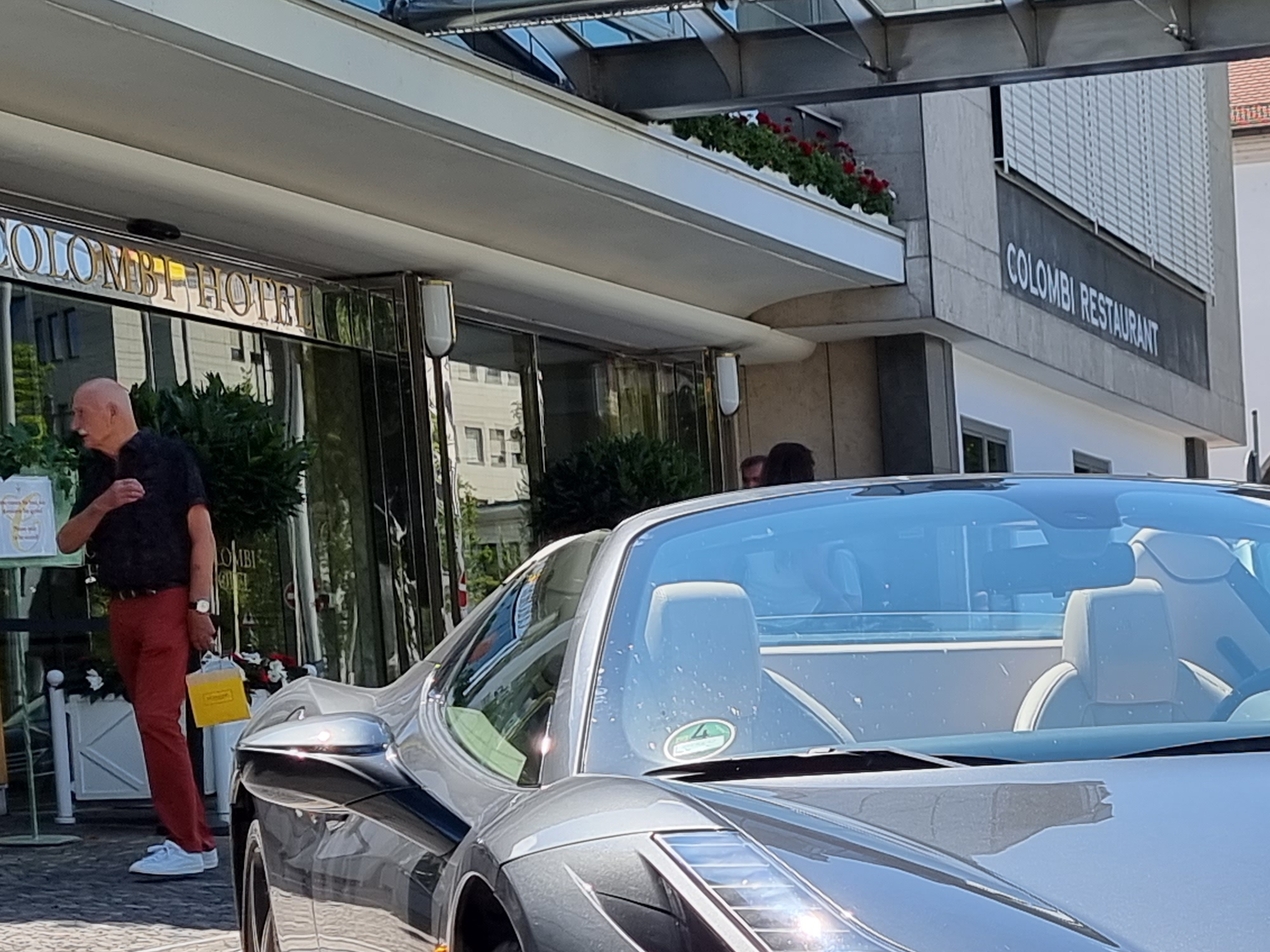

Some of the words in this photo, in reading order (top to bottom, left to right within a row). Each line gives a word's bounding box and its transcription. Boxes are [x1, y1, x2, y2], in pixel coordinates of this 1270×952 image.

[196, 262, 313, 331] HOTEL
[1007, 242, 1075, 314] COLOMBI
[1080, 282, 1159, 356] RESTAURANT
